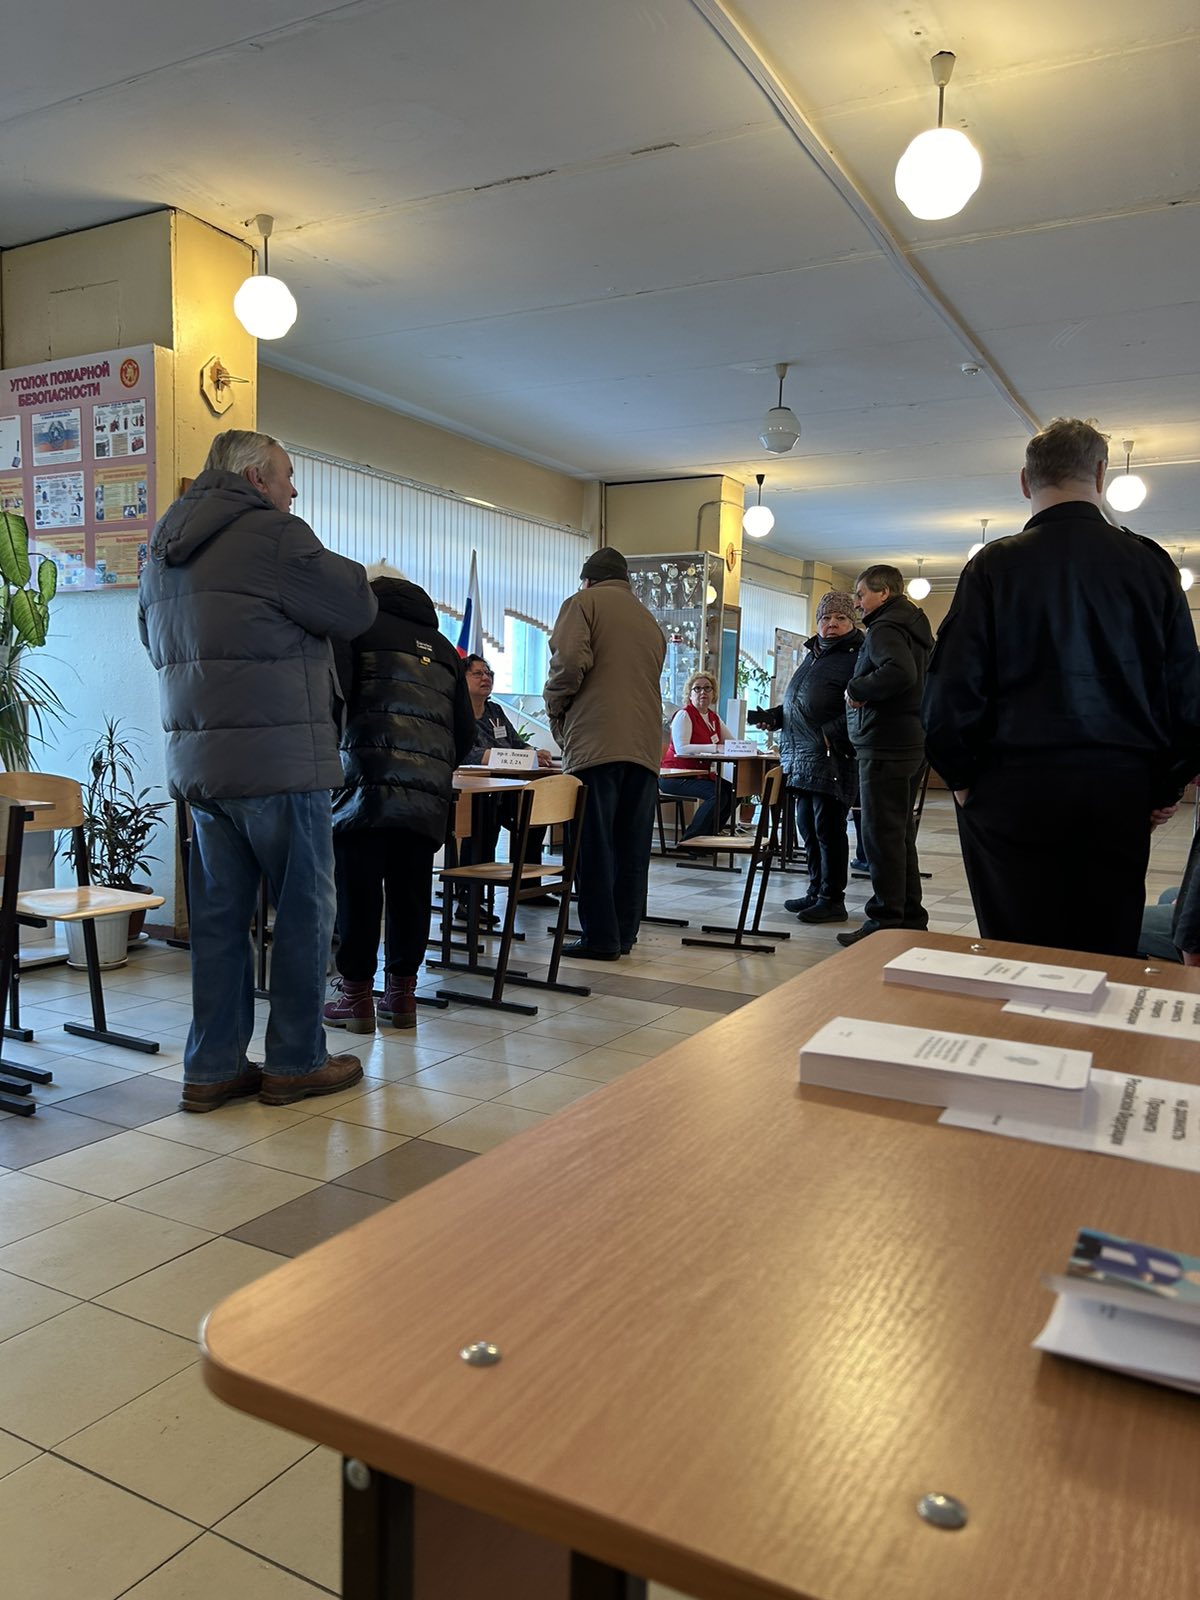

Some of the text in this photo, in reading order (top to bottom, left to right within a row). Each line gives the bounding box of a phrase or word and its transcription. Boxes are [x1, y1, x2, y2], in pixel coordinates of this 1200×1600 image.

[10, 361, 110, 392] УГОЛОК ПОЖАРНОЙ
[18, 382, 101, 407] БЕЗОПАСНОСТИ
